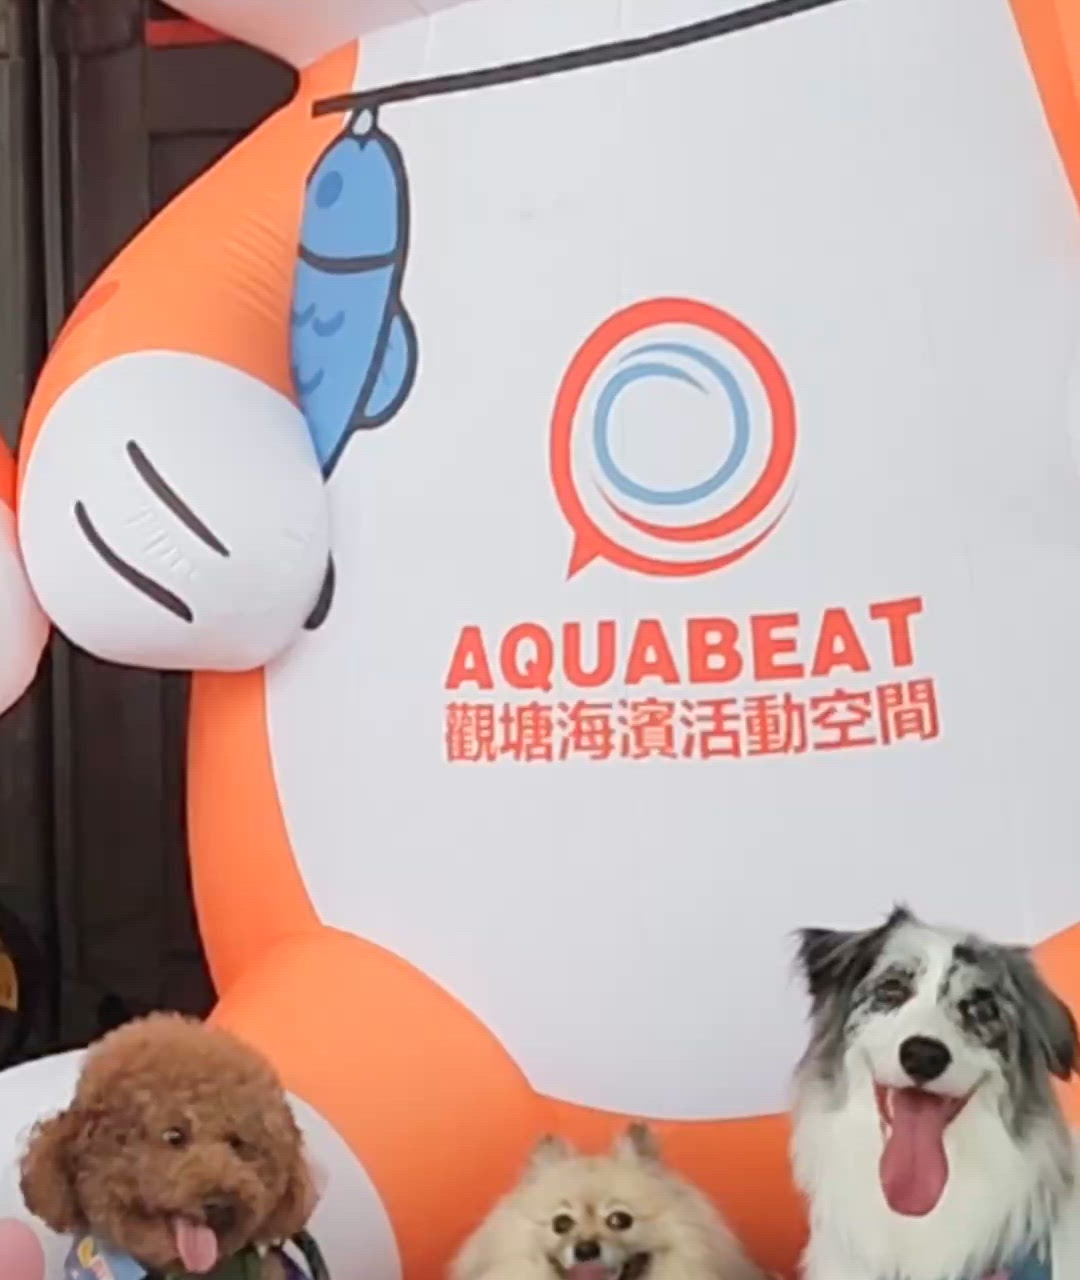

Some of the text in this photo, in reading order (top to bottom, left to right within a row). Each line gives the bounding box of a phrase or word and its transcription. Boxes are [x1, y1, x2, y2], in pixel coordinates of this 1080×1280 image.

[444, 597, 923, 692] AQUABEAT
[444, 678, 940, 762] 觀塘海濱活動空間
